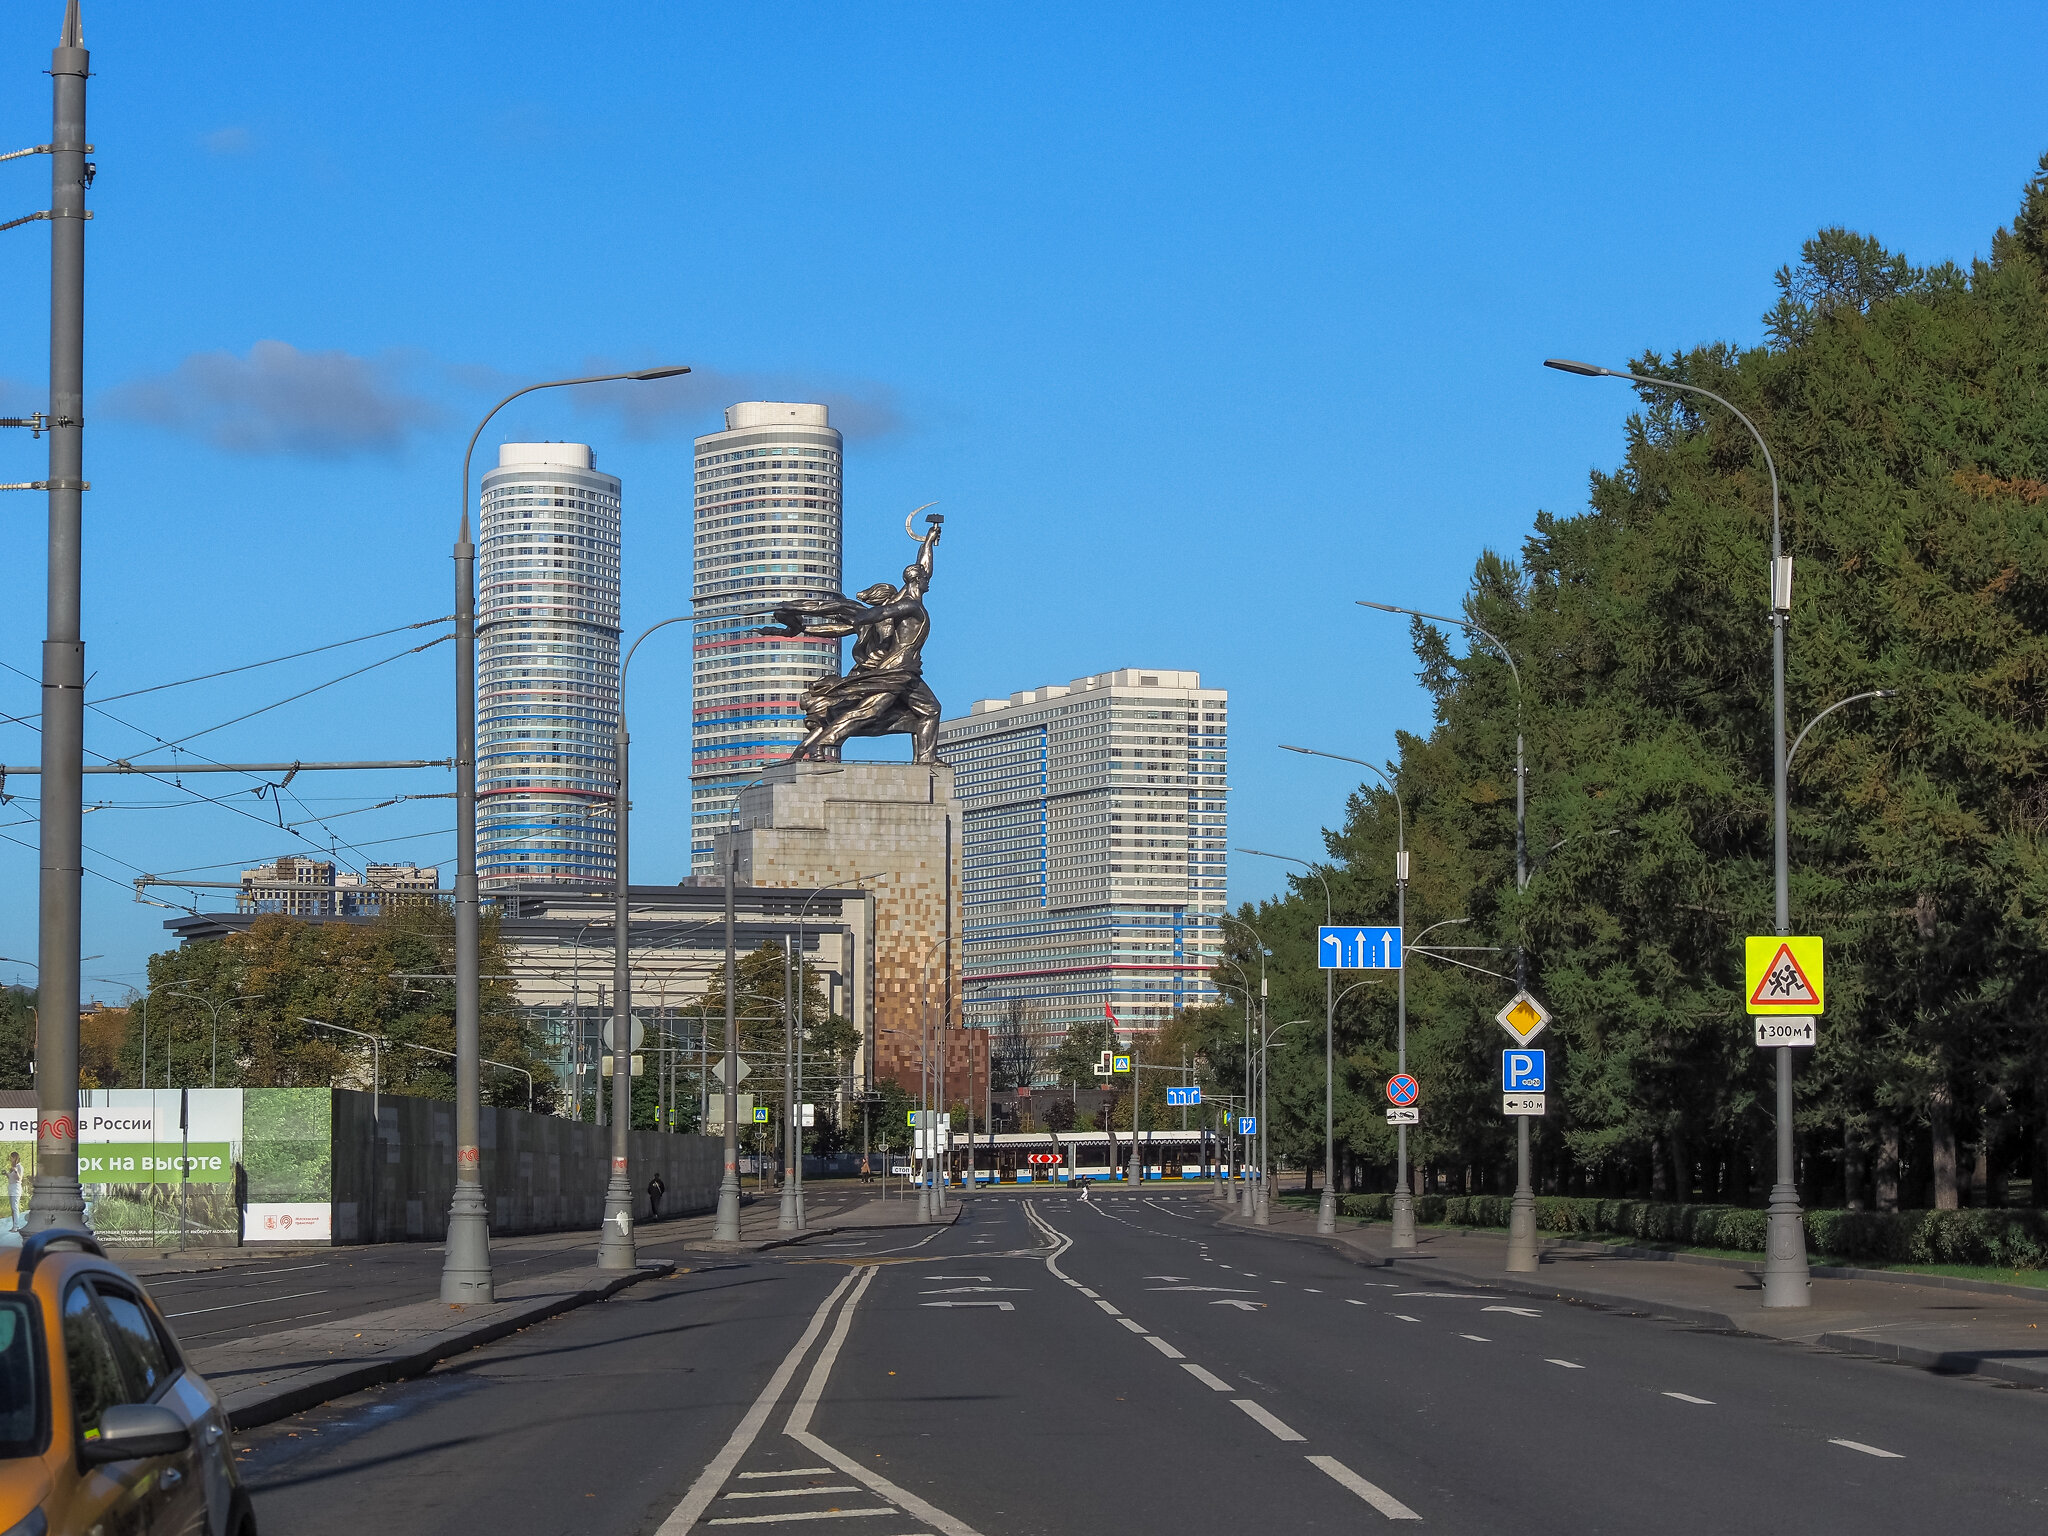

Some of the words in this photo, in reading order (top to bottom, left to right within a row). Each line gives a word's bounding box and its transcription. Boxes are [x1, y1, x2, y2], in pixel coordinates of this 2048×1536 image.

[1511, 1054, 1533, 1087] P
[1522, 1100, 1534, 1109] 50
[79, 1120, 88, 1130] в
[93, 1116, 152, 1130] России
[109, 1157, 135, 1171] на
[141, 1156, 222, 1171] высоте
